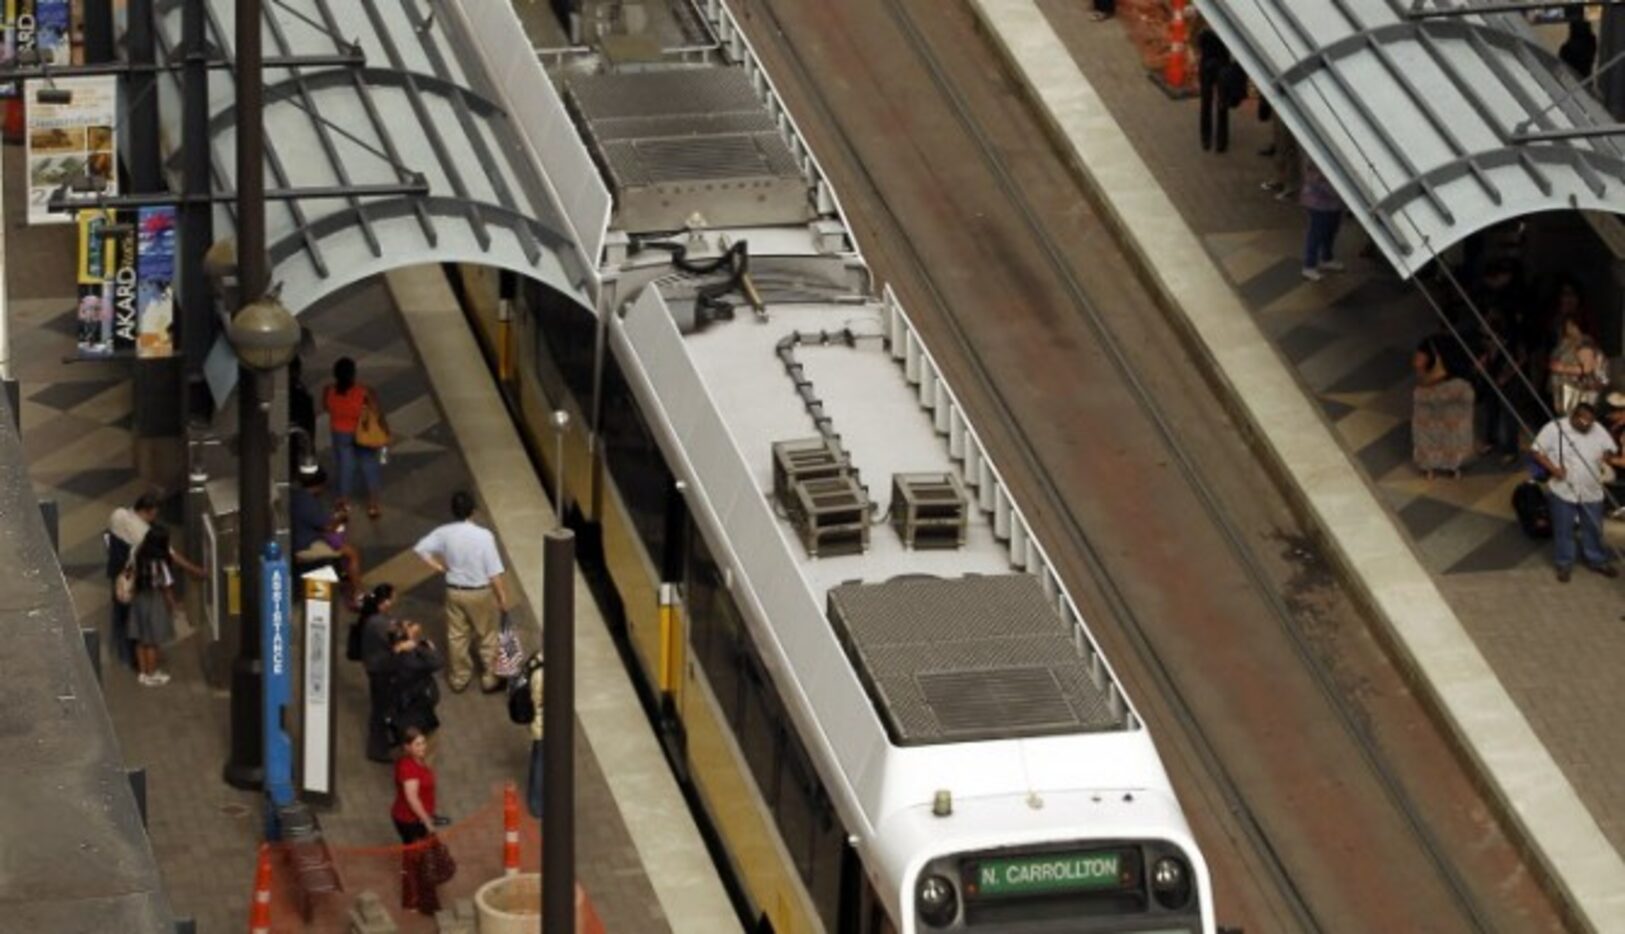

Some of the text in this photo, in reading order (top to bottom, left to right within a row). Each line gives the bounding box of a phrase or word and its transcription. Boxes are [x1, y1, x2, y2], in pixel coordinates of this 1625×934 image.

[116, 265, 136, 341] AKARD
[272, 570, 282, 675] ASSISTANCE
[982, 859, 1118, 885] N. CARROLLTON
